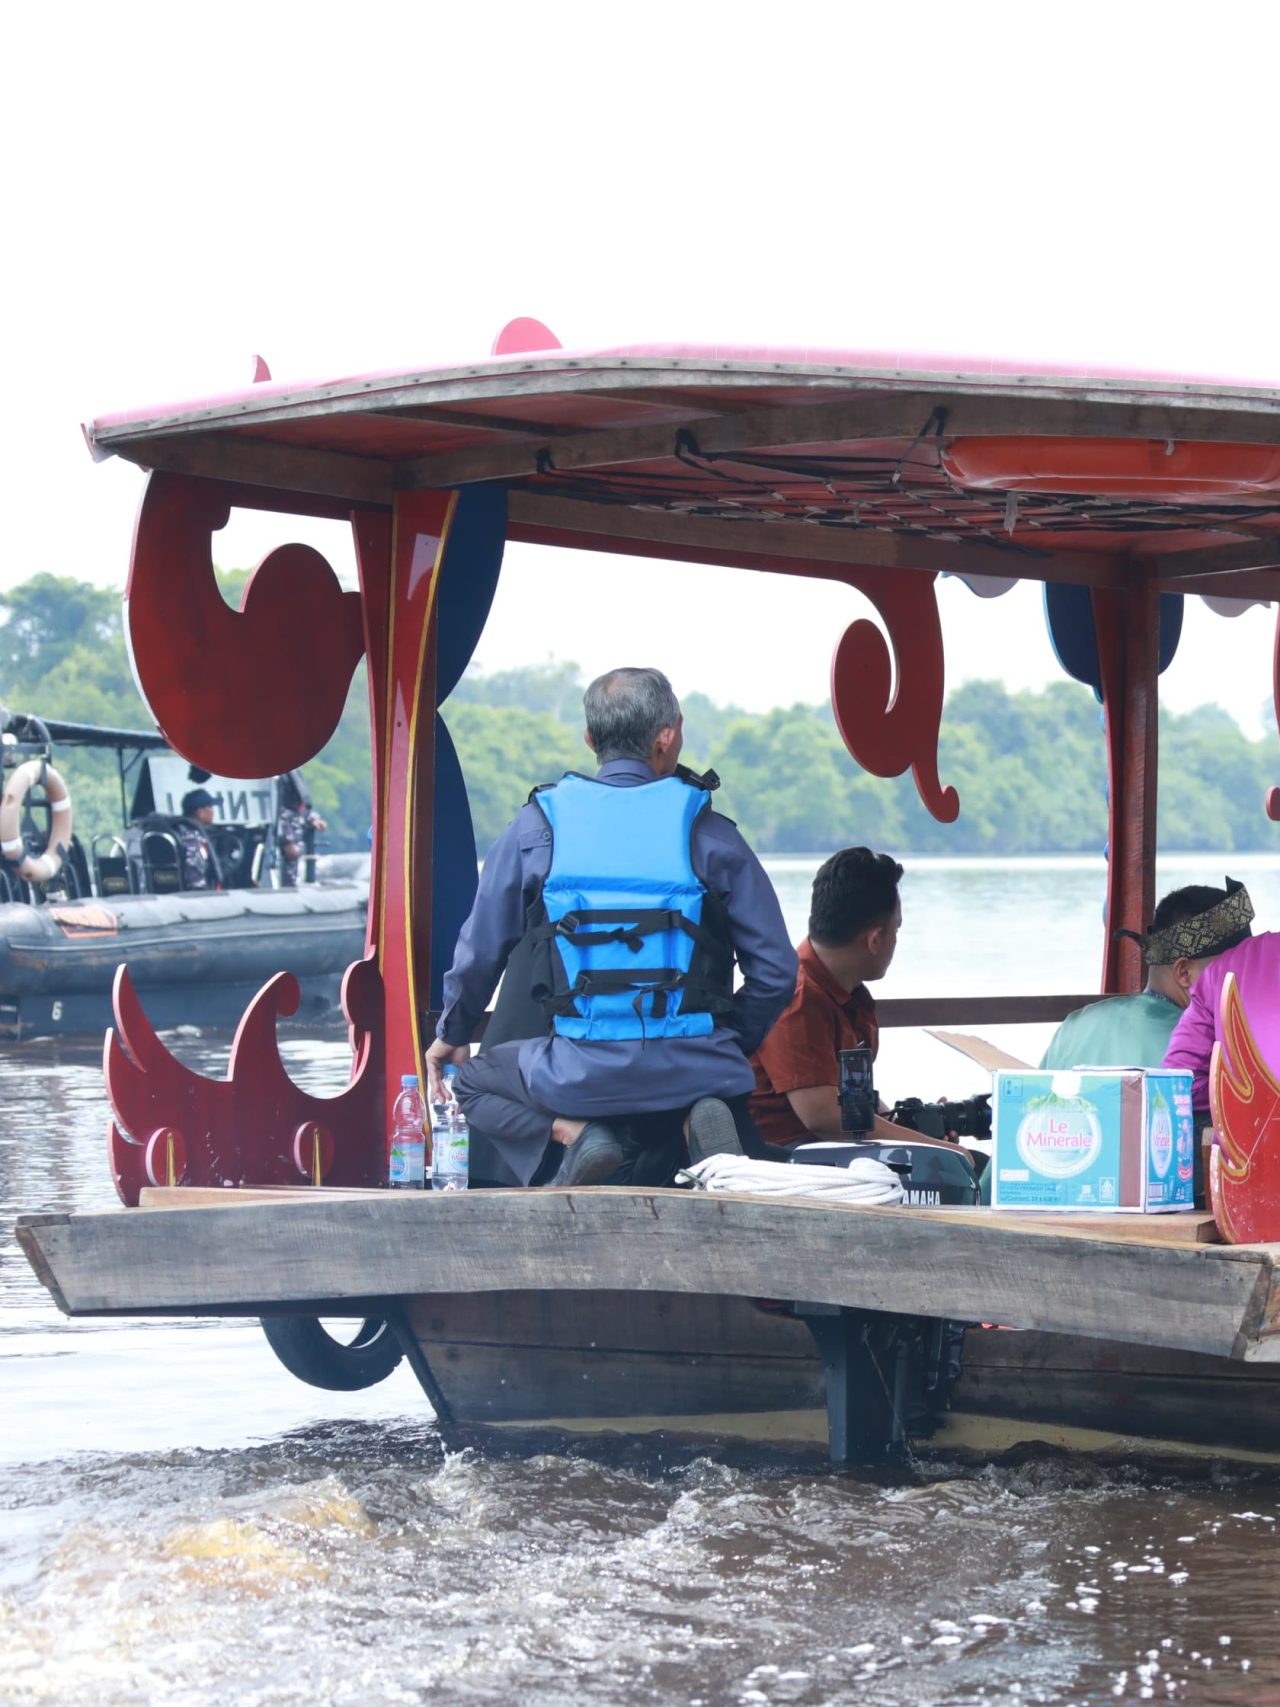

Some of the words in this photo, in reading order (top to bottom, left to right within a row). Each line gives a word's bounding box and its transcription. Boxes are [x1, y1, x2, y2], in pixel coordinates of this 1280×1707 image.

[52, 1001, 62, 1021] 6
[1050, 1118, 1068, 1134] Le
[1026, 1131, 1092, 1148] Minerale
[901, 1189, 941, 1206] AMAHA
